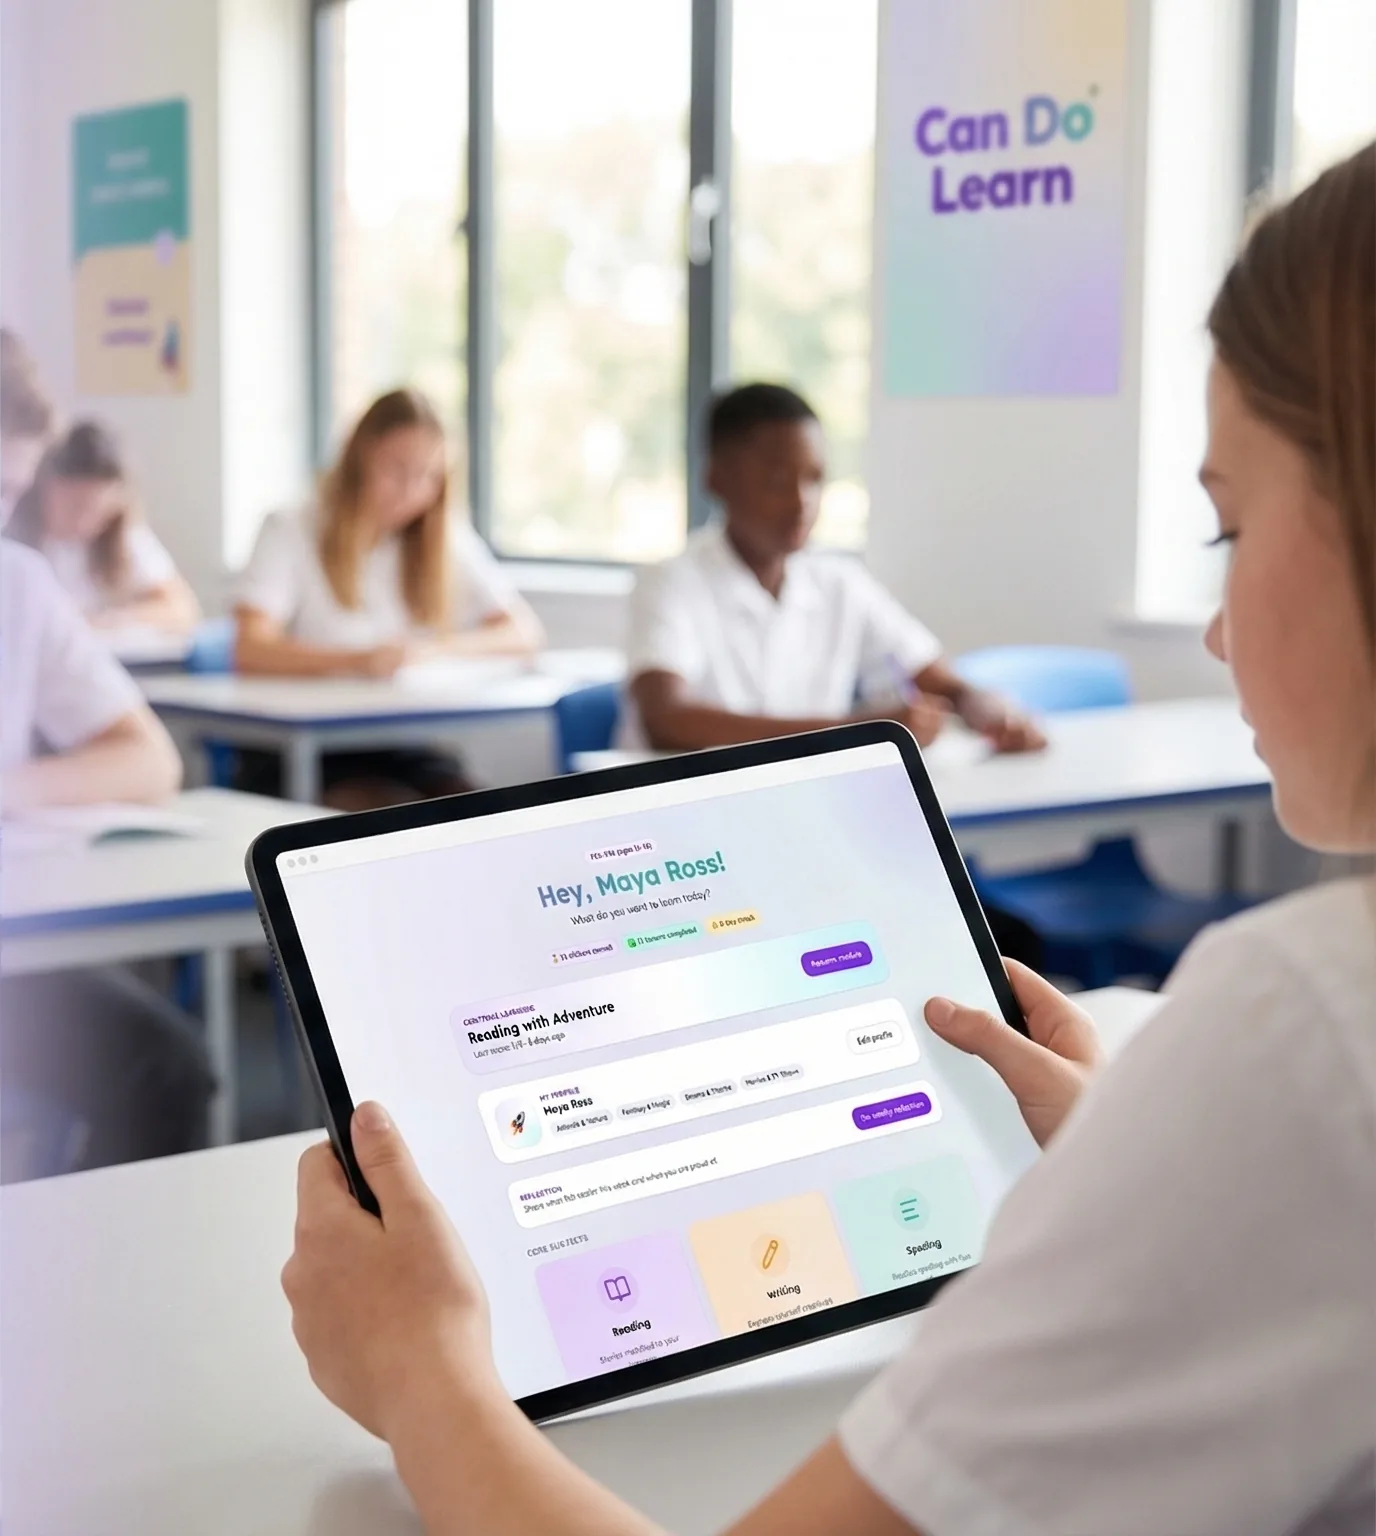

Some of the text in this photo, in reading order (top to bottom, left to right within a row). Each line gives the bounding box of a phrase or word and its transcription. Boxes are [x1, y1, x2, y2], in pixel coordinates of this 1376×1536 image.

[915, 94, 1094, 156] Can Do
[931, 163, 1073, 214] Learn
[537, 884, 592, 908] Hey,
[596, 868, 661, 896] Maya
[665, 851, 726, 882] Ross!
[467, 1024, 520, 1044] Reading
[522, 1014, 550, 1031] with
[552, 1003, 615, 1025] Adventure
